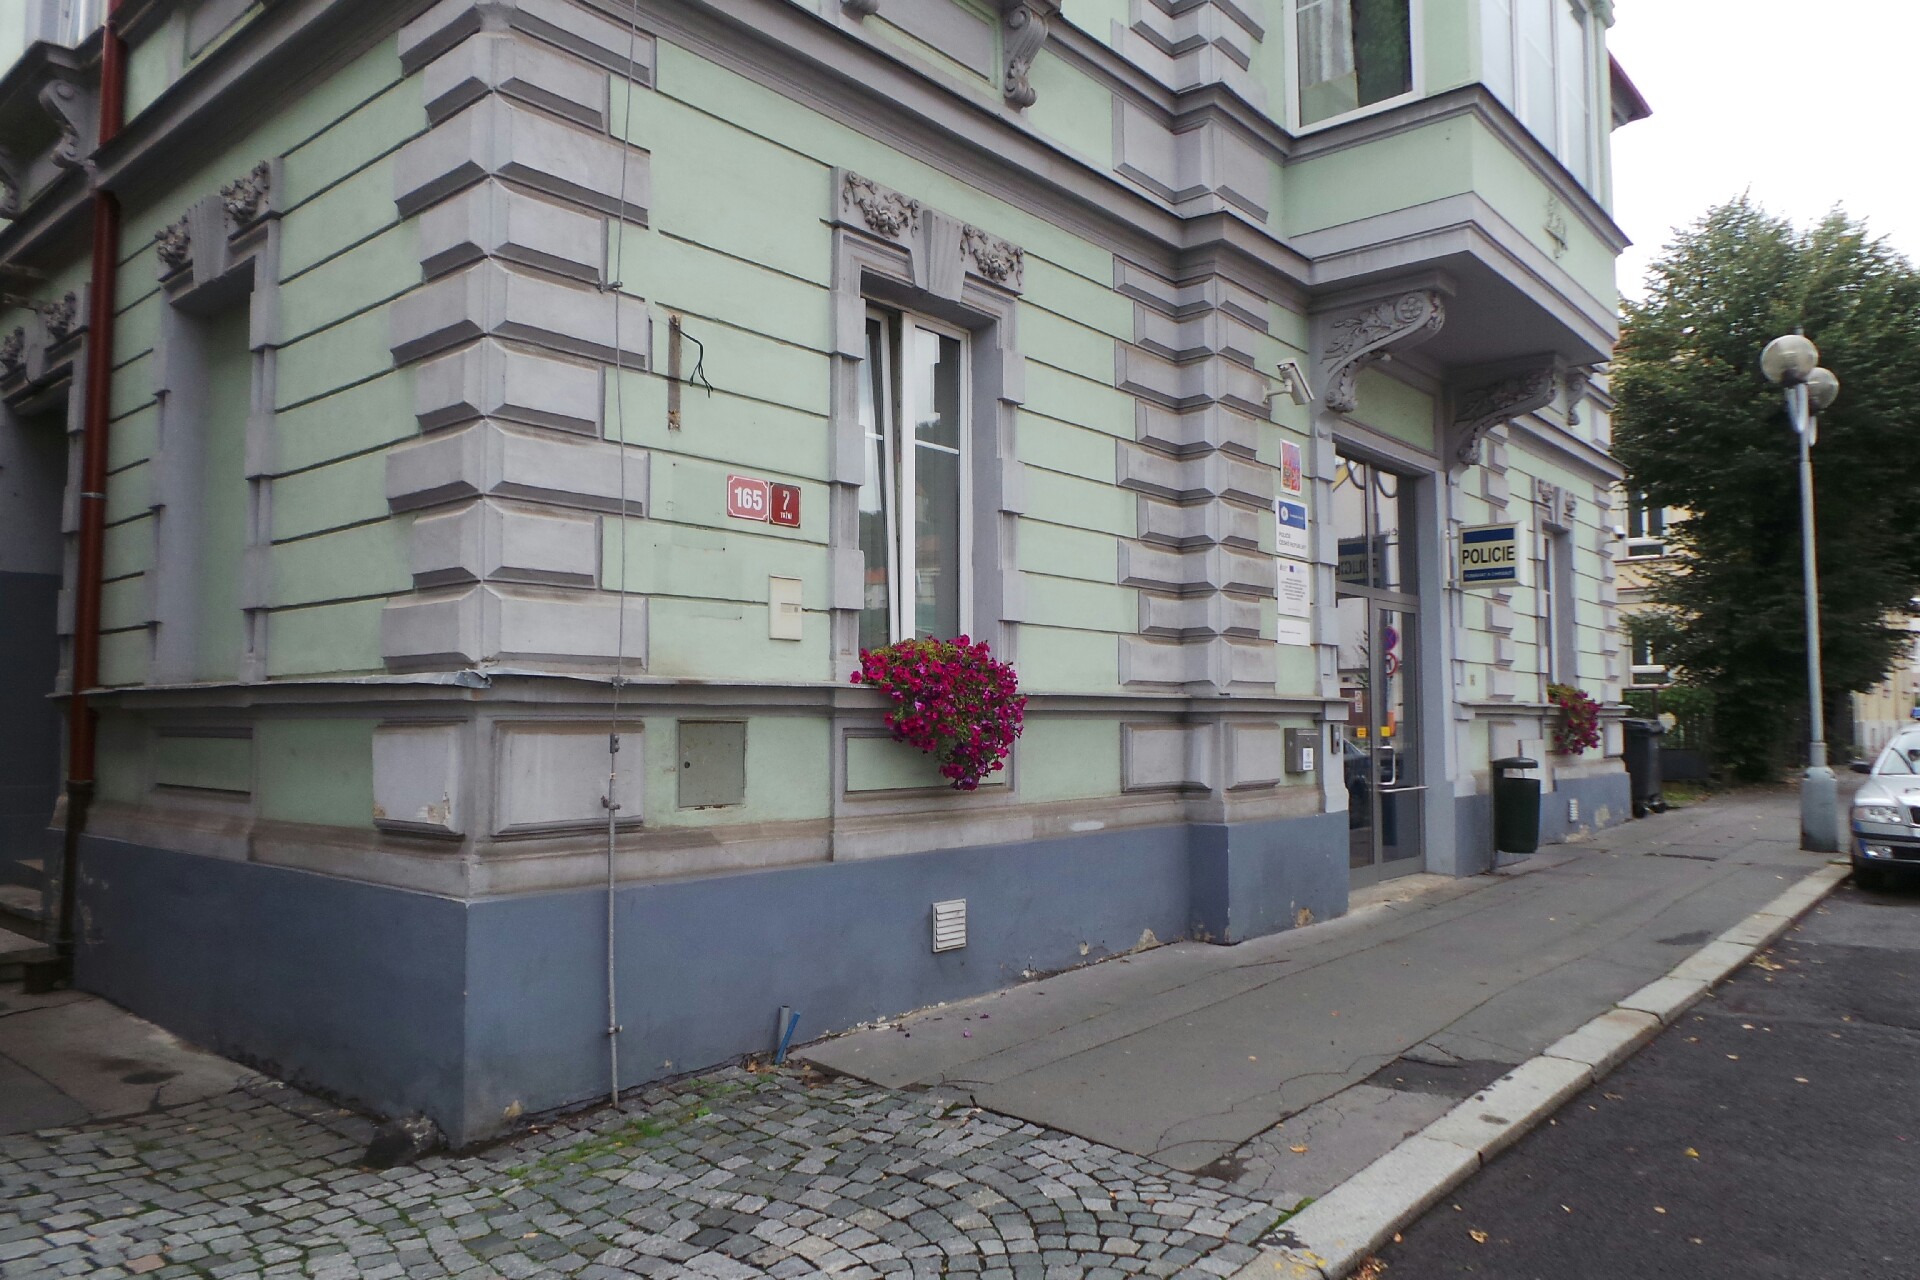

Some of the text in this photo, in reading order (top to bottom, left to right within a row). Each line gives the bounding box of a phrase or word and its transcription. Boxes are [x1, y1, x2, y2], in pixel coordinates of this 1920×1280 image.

[735, 487, 762, 510] 165
[783, 490, 790, 510] 7
[1462, 545, 1515, 565] POLICIE
